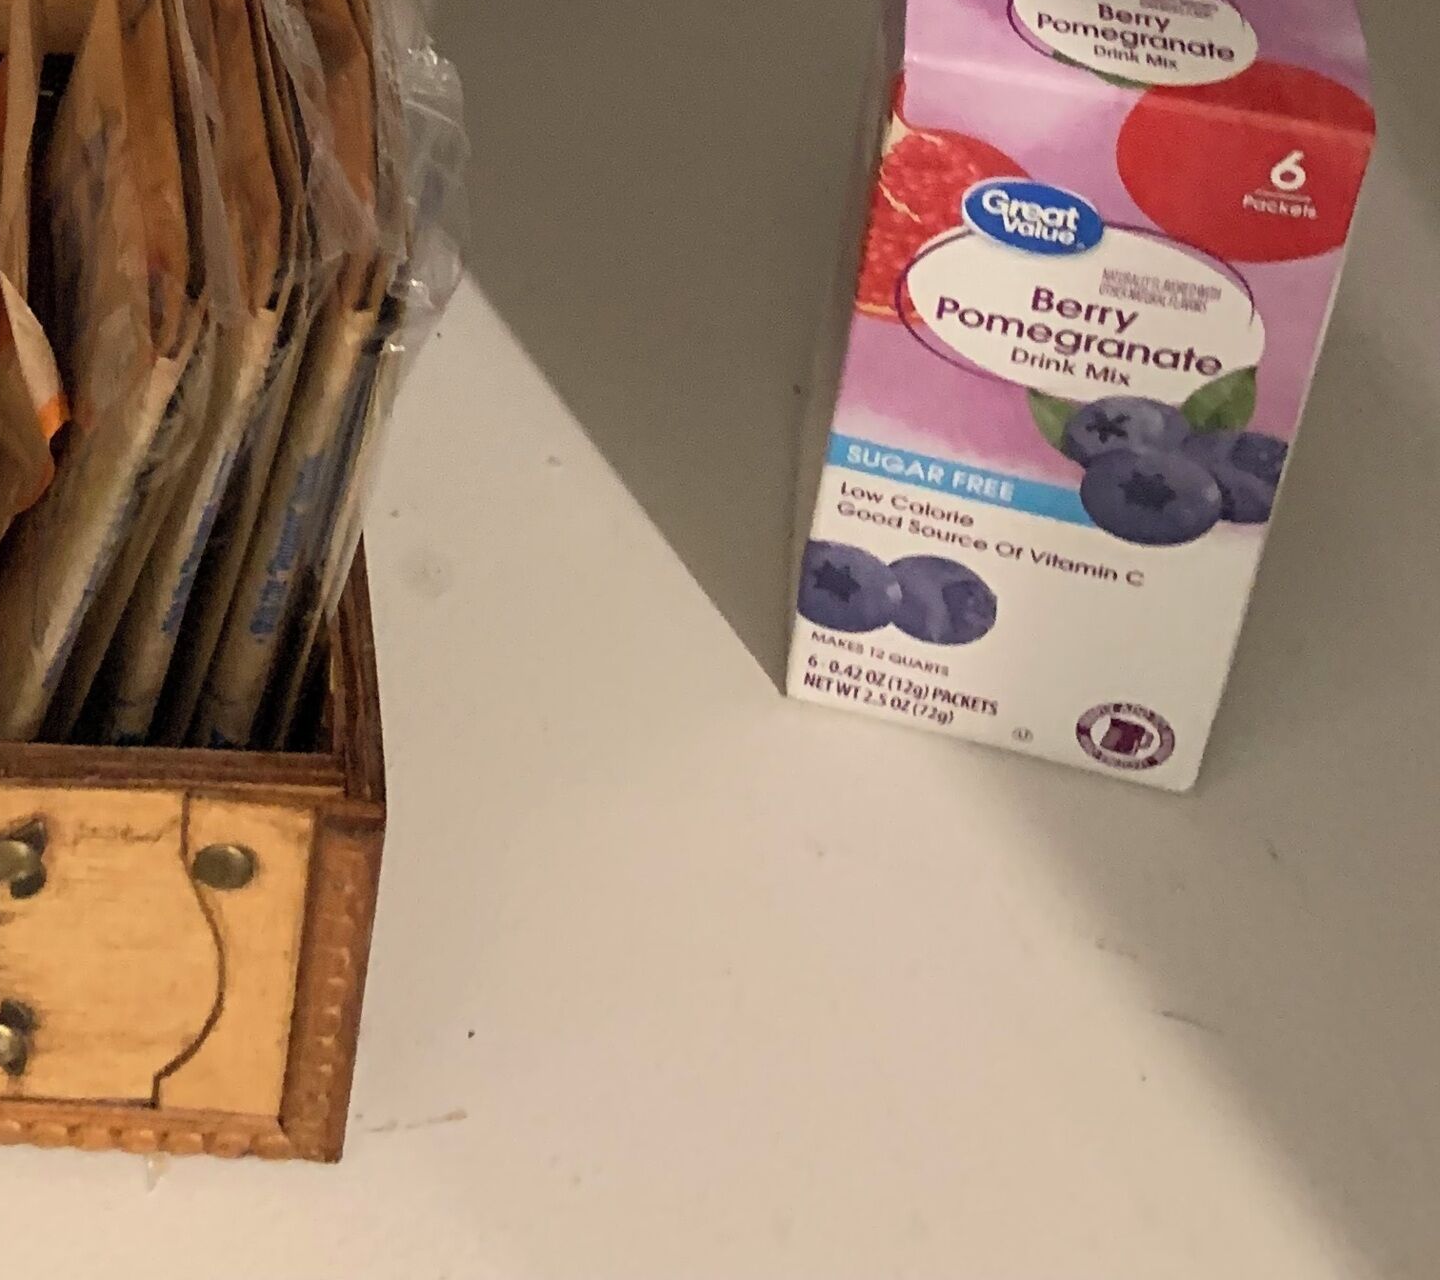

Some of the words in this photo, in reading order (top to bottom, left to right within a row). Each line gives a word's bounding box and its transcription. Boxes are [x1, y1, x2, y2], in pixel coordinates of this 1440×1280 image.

[1037, 12, 1235, 62] Pomegranate
[1097, 3, 1170, 33] Berry
[1094, 44, 1140, 64] Drink
[1146, 54, 1178, 70] Mix
[1270, 150, 1307, 191] 6
[982, 189, 1081, 231] Great
[1242, 193, 1317, 220] Packets
[1002, 213, 1076, 245] Value
[1031, 286, 1140, 333] Berry
[936, 296, 1224, 377] Pomegranate
[1010, 347, 1075, 376] Drink
[1085, 362, 1131, 388] Mix
[846, 444, 945, 485] SUGAR
[952, 471, 1015, 501] FREE
[841, 481, 883, 504] Low
[890, 494, 975, 528] Calorie
[837, 500, 902, 529] Good
[908, 519, 988, 551] Source
[995, 540, 1024, 560] Of
[1029, 549, 1118, 582] Vitamin
[1125, 570, 1146, 586] C
[811, 630, 864, 655] MAKES
[888, 651, 949, 677] QUARTS
[803, 672, 834, 692] NET
[836, 681, 861, 700] WT
[890, 695, 911, 713] OZ
[808, 654, 818, 669] 6
[866, 669, 887, 687] OZ
[887, 675, 930, 701] (12g)
[932, 687, 999, 717] PACKETS
